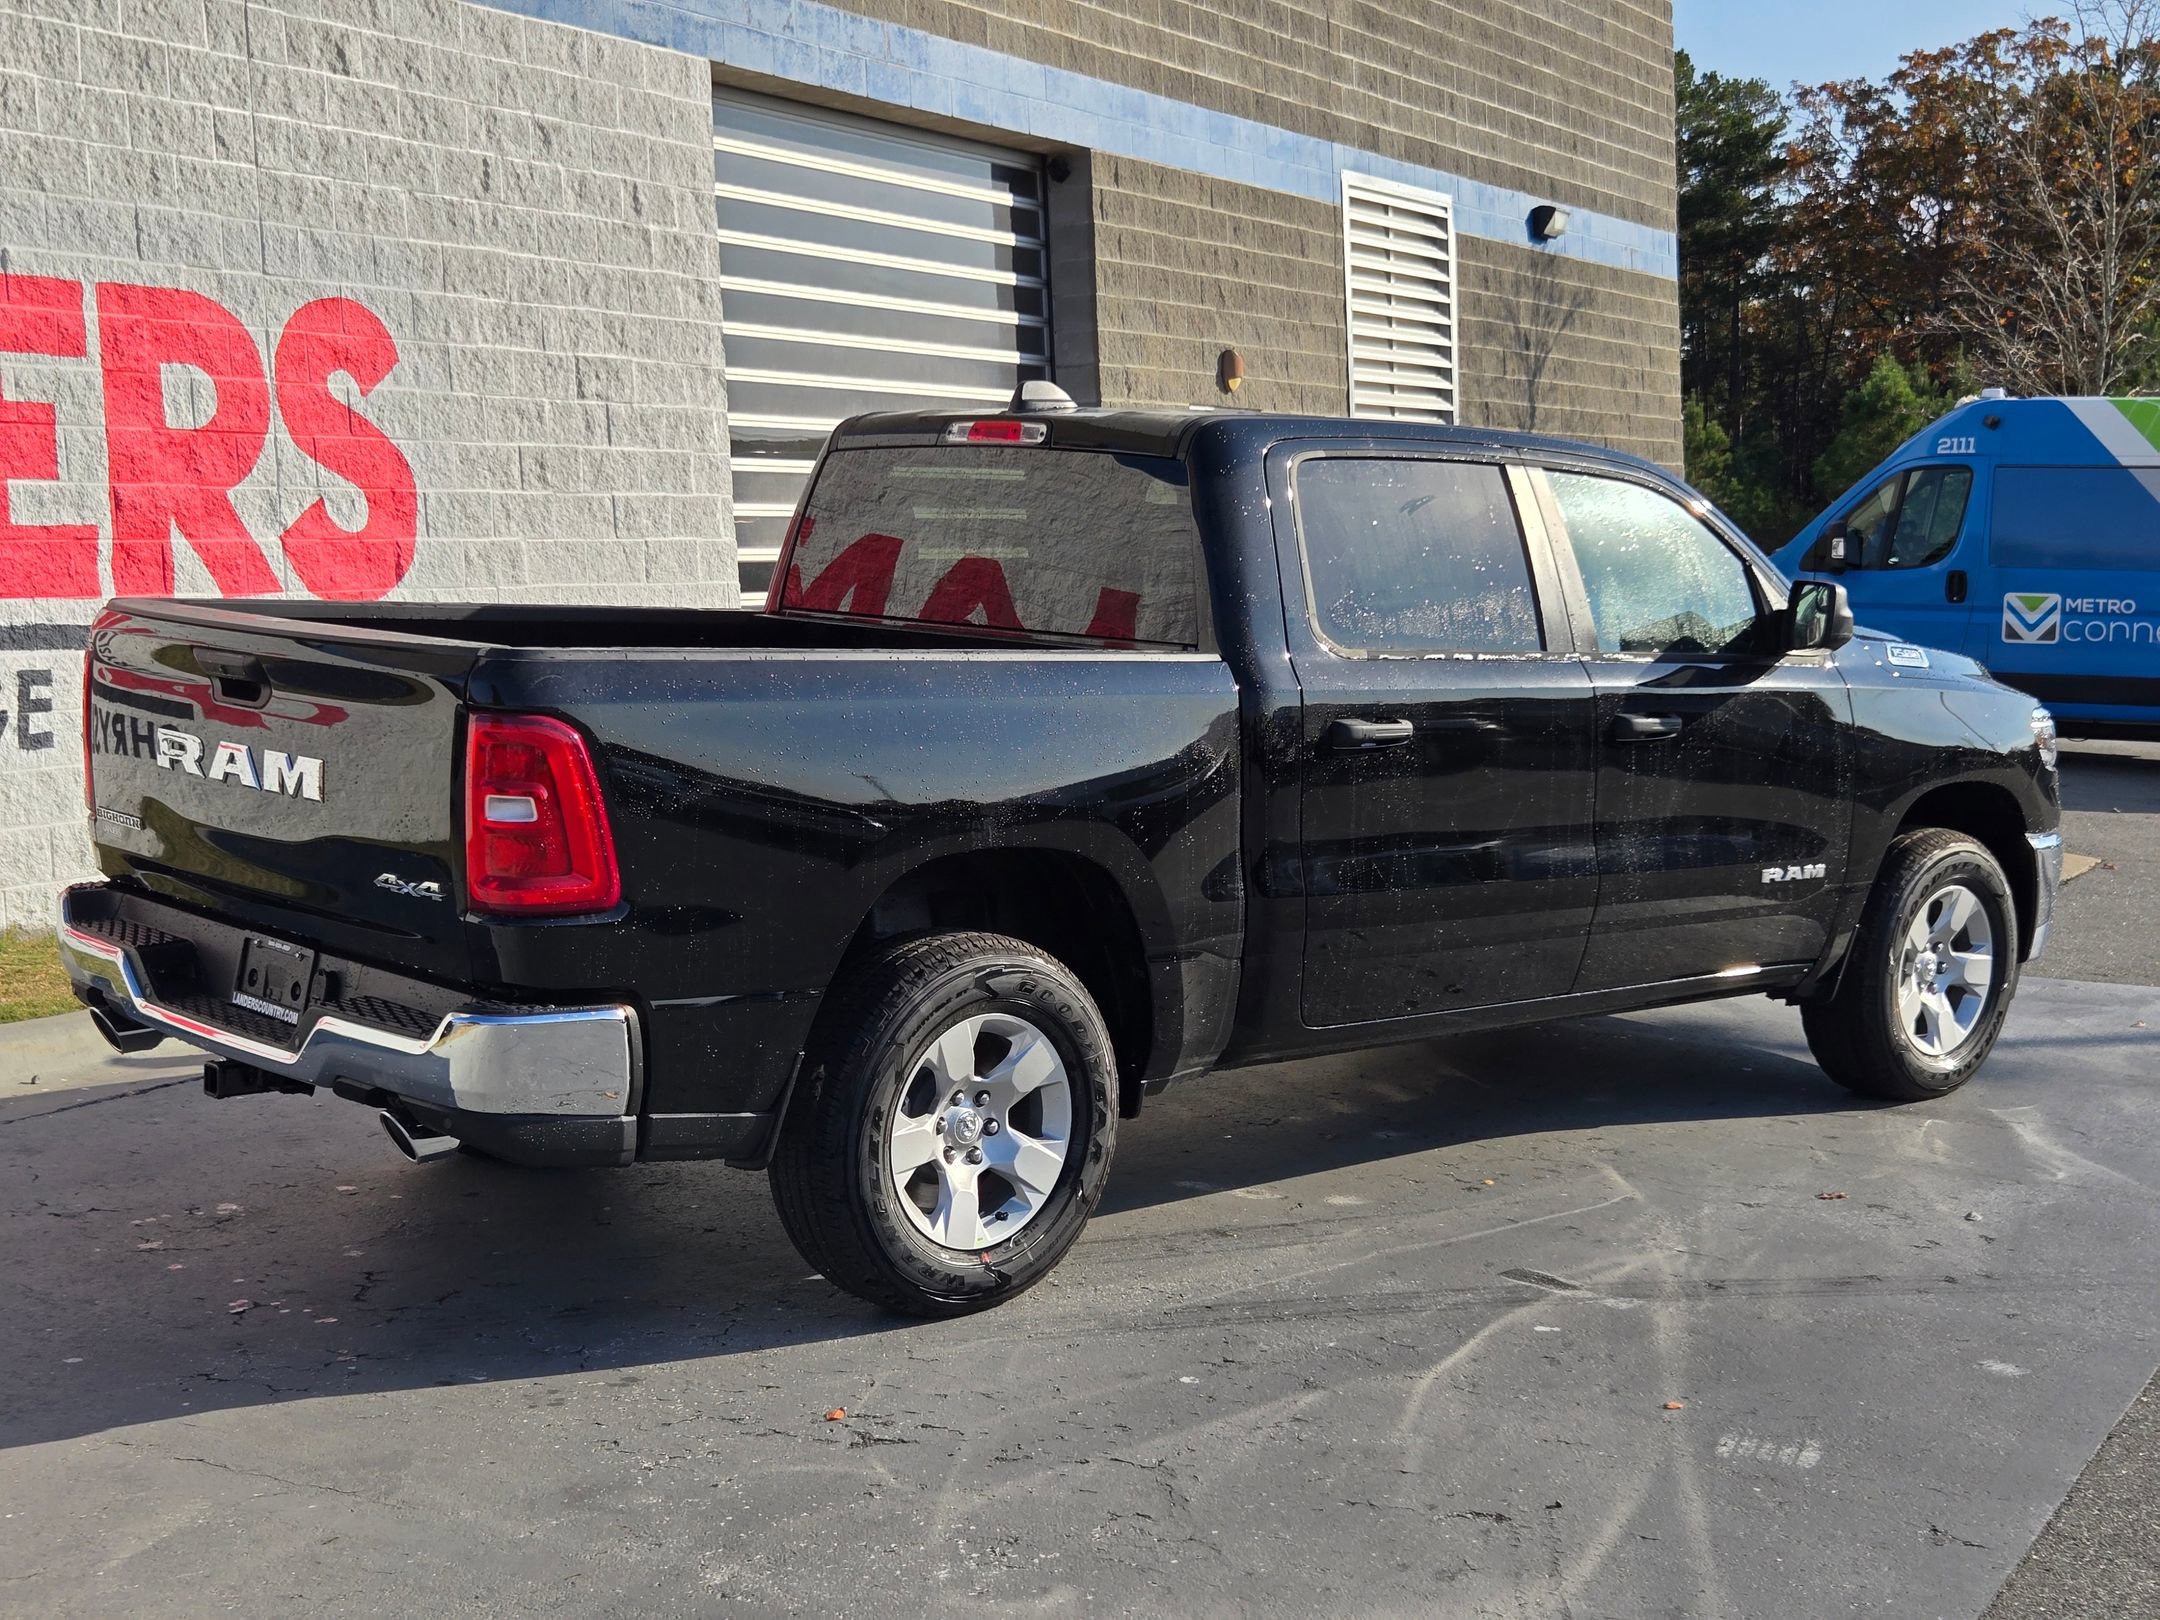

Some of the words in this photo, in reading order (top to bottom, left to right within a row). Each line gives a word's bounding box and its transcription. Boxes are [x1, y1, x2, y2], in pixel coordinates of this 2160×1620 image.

[0, 274, 418, 601] ERS
[1936, 437, 1976, 454] 2111
[2065, 598, 2136, 614] METRO
[2063, 620, 2160, 643] conn
[0, 669, 54, 751] E
[156, 727, 325, 803] RAM
[1761, 864, 1826, 884] RAM
[232, 991, 299, 1025] LANDERSCOUNTRY.COM
[1013, 978, 1109, 1166] GOODYEAR
